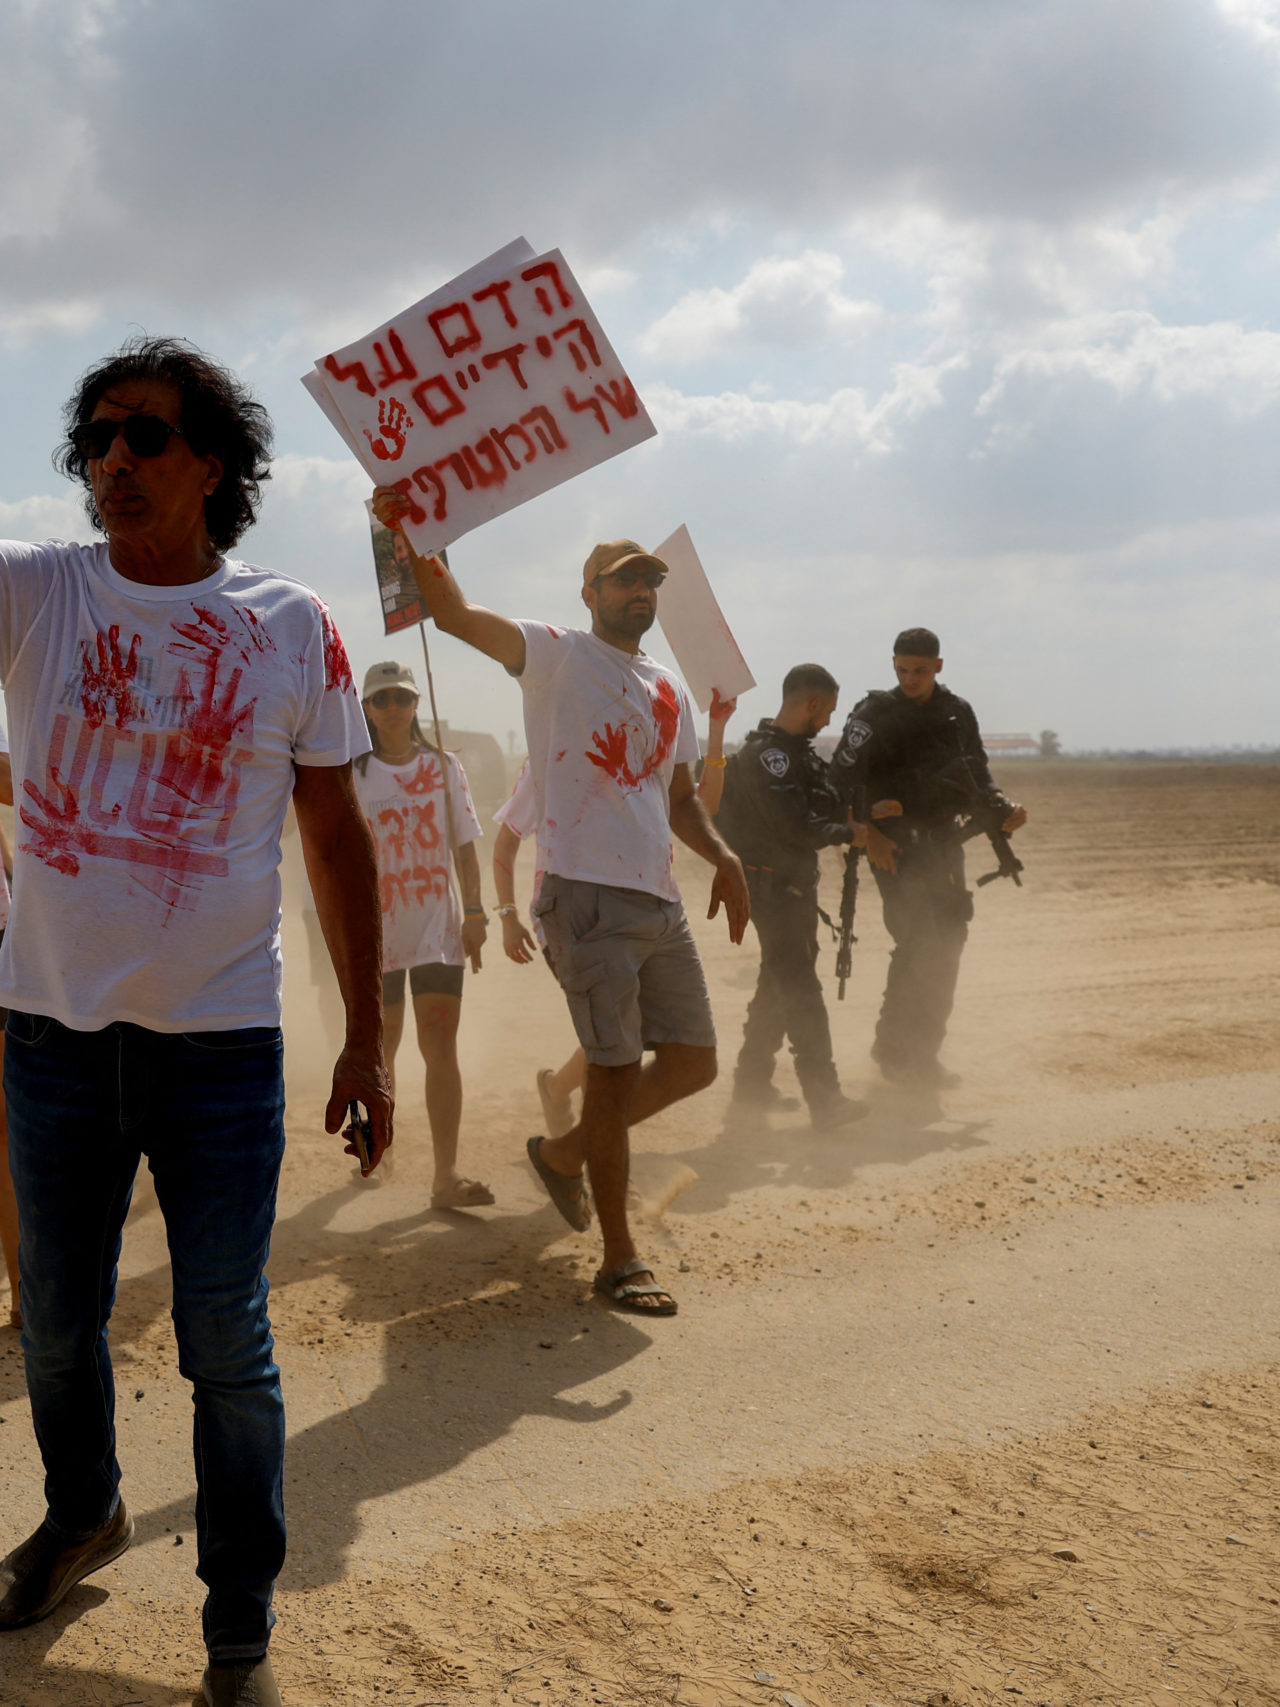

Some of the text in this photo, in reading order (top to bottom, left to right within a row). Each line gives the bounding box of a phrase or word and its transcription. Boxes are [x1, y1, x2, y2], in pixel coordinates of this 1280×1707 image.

[324, 261, 574, 397] הדם על
[411, 318, 601, 427] הידיים
[562, 376, 638, 435] של
